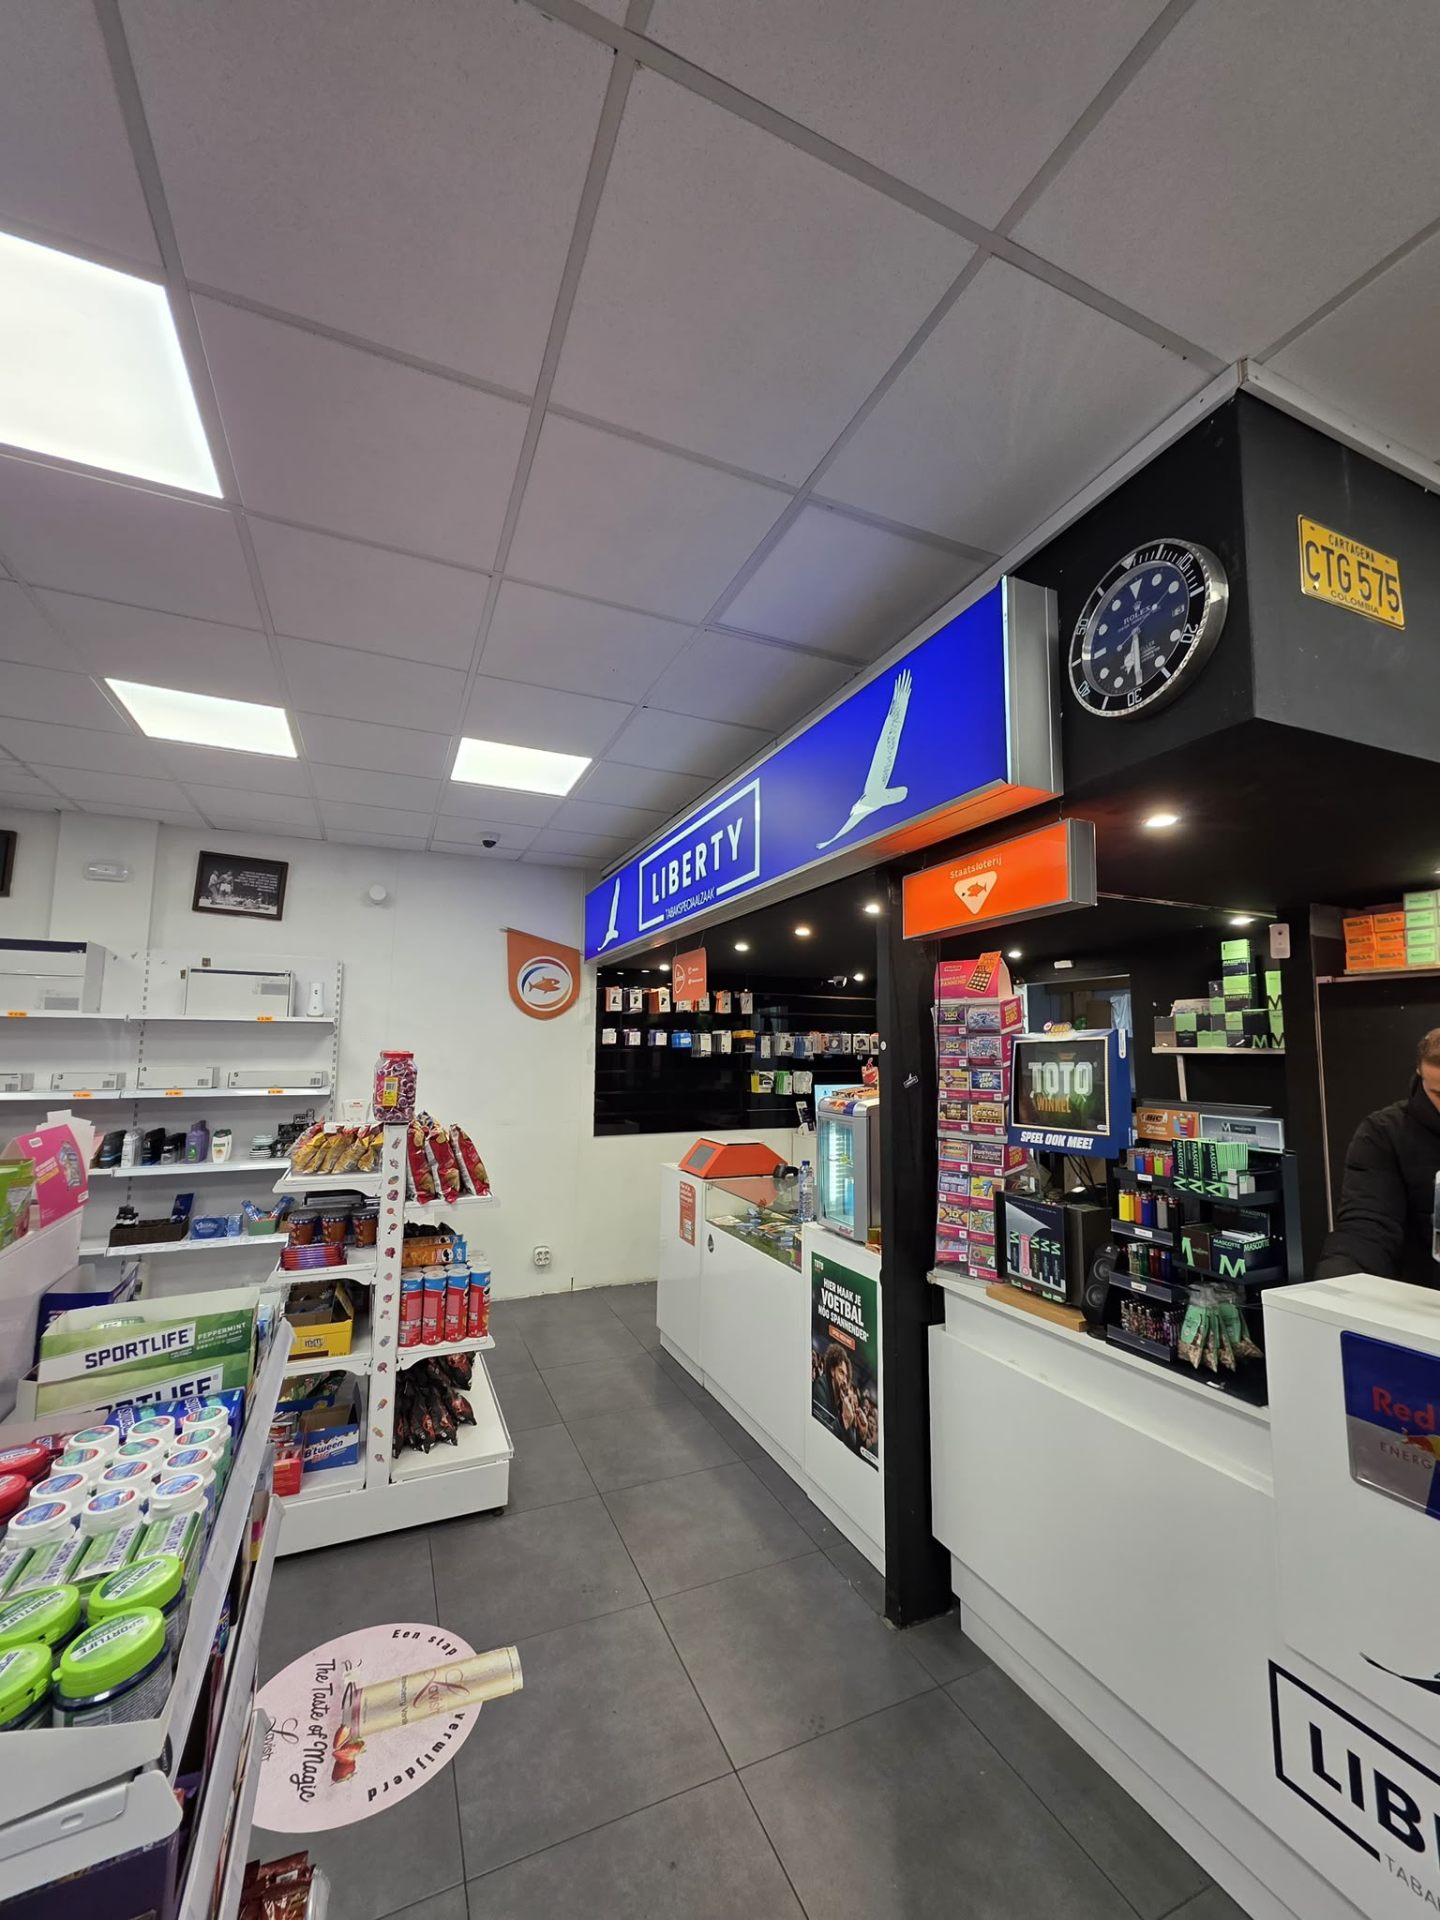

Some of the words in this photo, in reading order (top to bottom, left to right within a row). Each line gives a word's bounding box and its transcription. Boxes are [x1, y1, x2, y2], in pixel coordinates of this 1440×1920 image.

[1328, 534, 1376, 563] CARTAGENA
[1305, 540, 1352, 594] CTG
[1357, 560, 1400, 613] 575
[1330, 589, 1380, 615] COLOMBIA
[1181, 623, 1199, 643] 20
[1127, 687, 1143, 707] 30
[652, 817, 743, 904] LIBERTY
[949, 854, 1002, 880] Staatsloterij
[1027, 1062, 1093, 1097] TOTO
[1020, 1131, 1044, 1143] SPEEL
[1044, 1134, 1067, 1147] OOK
[1066, 1137, 1094, 1150] MEE!
[1190, 1142, 1200, 1179] MASCOTTE
[1208, 1144, 1219, 1182] MASCOTTE
[821, 1288, 865, 1327] VOETBAL
[823, 1277, 837, 1293] HIER
[836, 1284, 854, 1303] MAAK
[854, 1294, 862, 1307] JE
[198, 1321, 246, 1340] PEPPERMINT
[85, 1328, 189, 1370] SPORTLIFE
[1371, 1385, 1436, 1431] Red
[79, 1616, 146, 1655] SPORTLIFE
[392, 1629, 421, 1640] Een
[428, 1634, 459, 1656] stap
[315, 1659, 337, 1684] The
[311, 1684, 334, 1720] Taste
[307, 1723, 329, 1745] of
[290, 1740, 330, 1803] Magic
[366, 1711, 467, 1802] verwijderd
